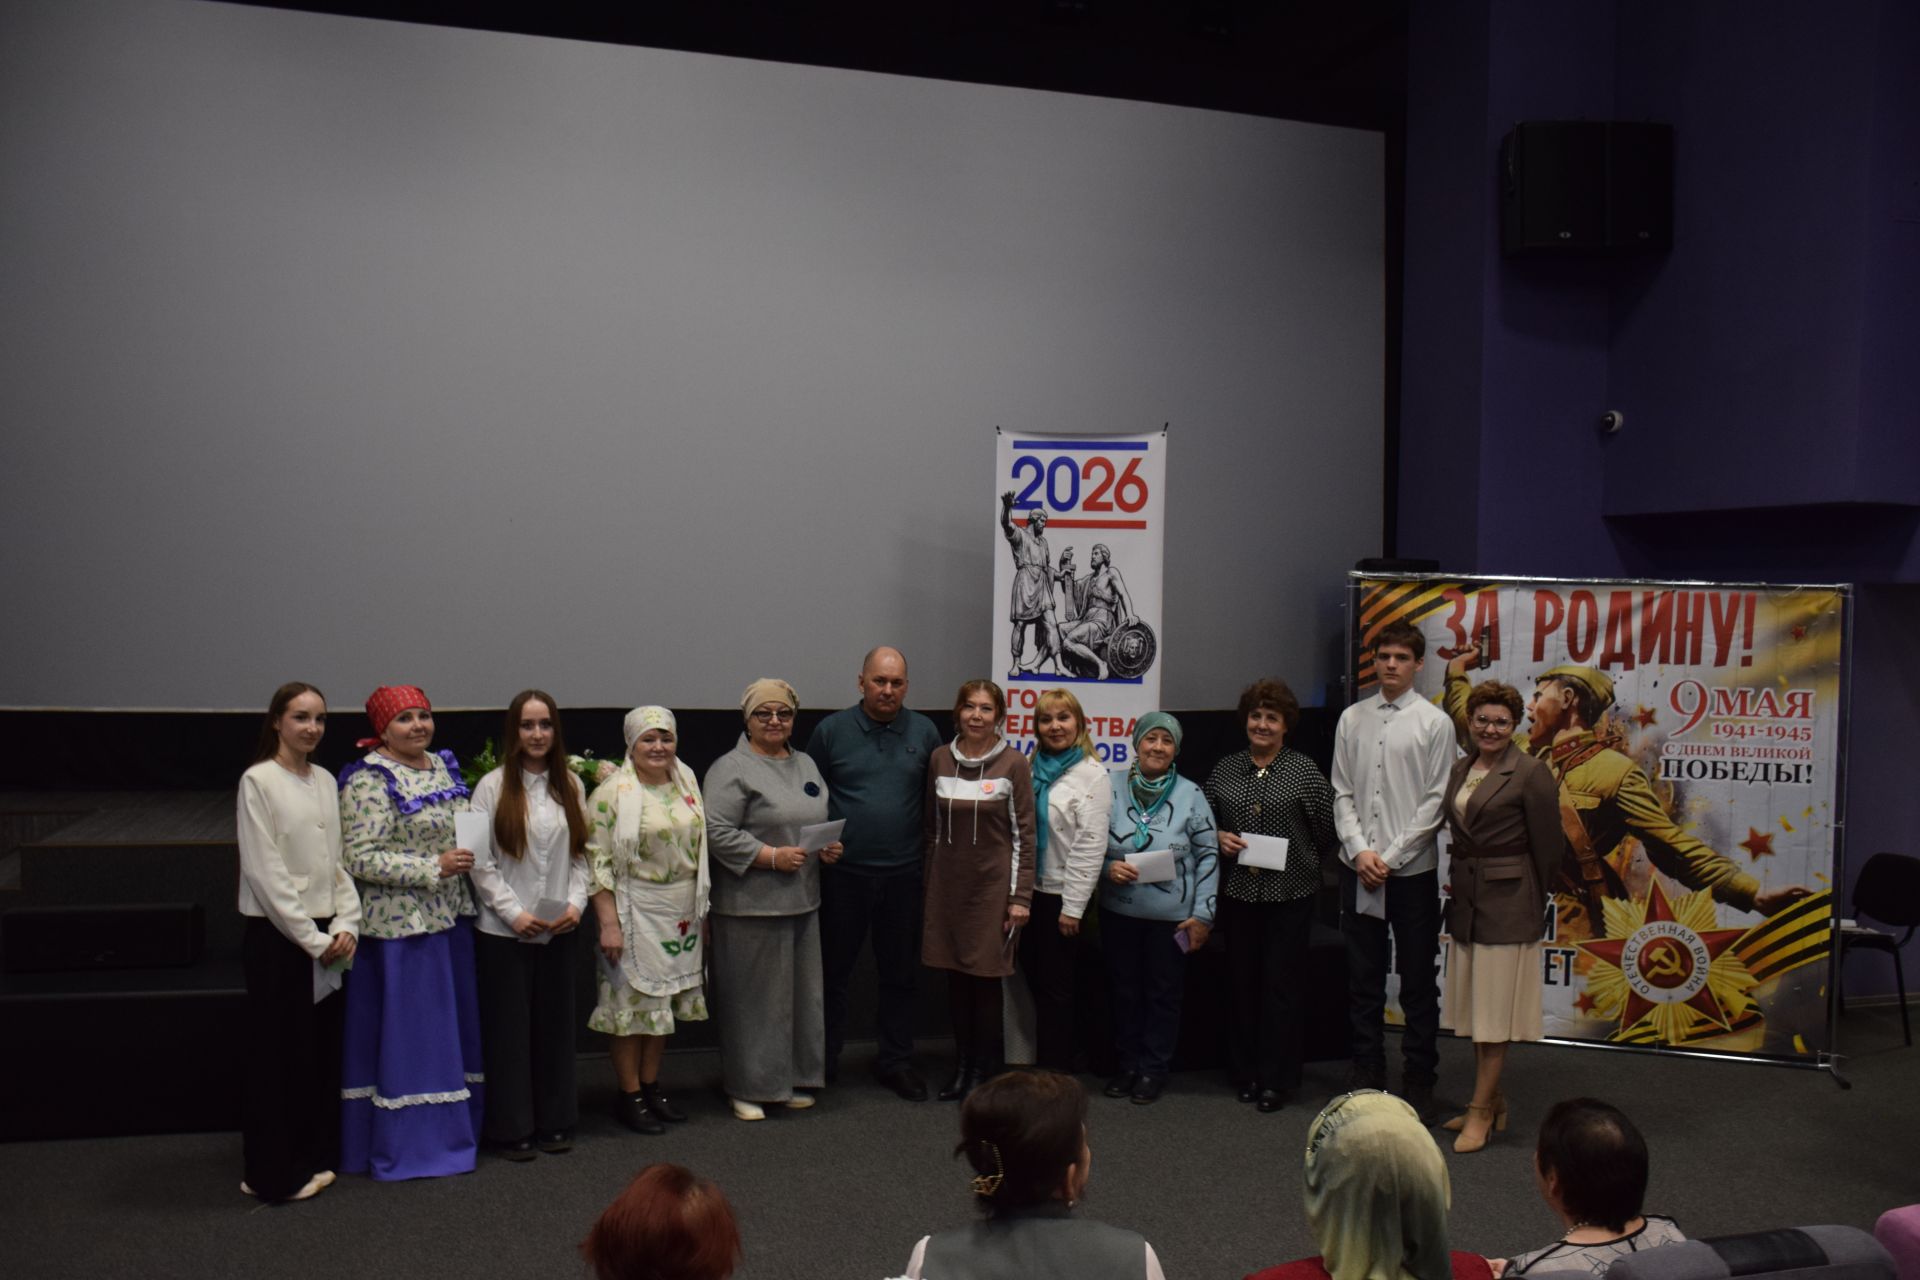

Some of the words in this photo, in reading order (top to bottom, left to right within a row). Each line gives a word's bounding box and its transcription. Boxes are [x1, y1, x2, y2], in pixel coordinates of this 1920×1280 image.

[1011, 455, 1149, 513] 2026
[1436, 588, 1501, 671] ЗА
[1533, 589, 1757, 671] РОДИНУ!
[1007, 688, 1052, 709] ГО
[1670, 679, 1708, 737] 9
[1713, 688, 1814, 719] МАЯ
[1664, 744, 1676, 756] С
[1678, 744, 1726, 758] ДНЕМ
[1730, 747, 1811, 761] ВЕЛИКОЙ
[1713, 724, 1812, 742] 1941-1945
[1661, 757, 1813, 786] ПОБЕДЫ!
[1624, 924, 1696, 994] ОТЕЧЕСТВЕННАЯ
